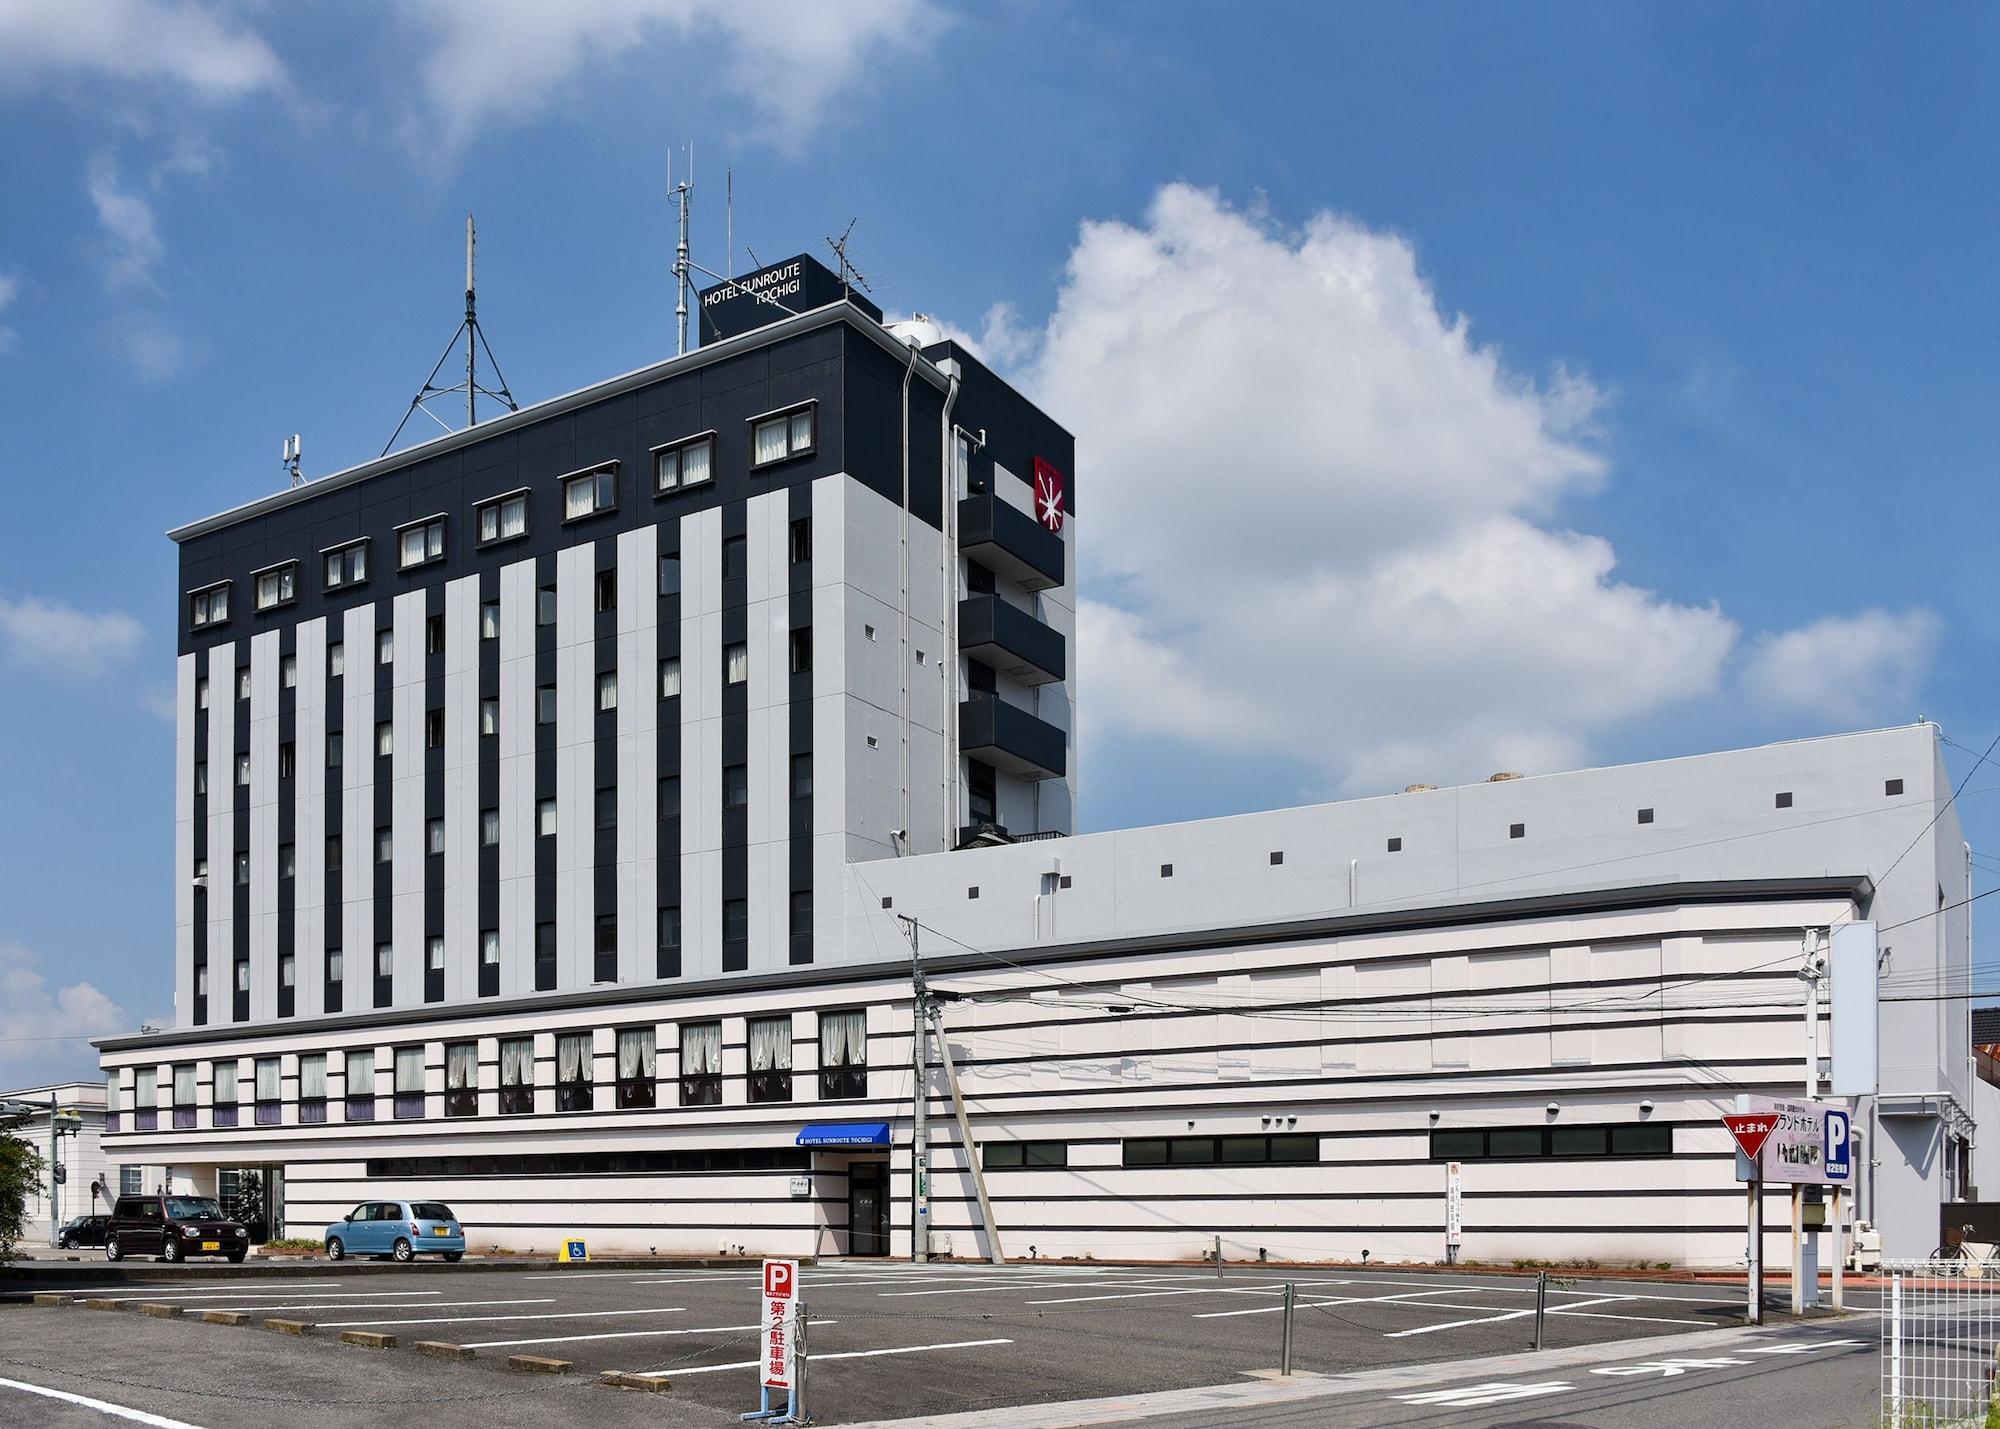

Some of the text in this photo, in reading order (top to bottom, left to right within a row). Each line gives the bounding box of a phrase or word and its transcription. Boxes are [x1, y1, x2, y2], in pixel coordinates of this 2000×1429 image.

[704, 262, 800, 307] HOTEL SUNROUTE
[756, 279, 800, 305] TOCHIGI
[1734, 1122, 1769, 1134] 止まれ
[1828, 1115, 1846, 1161] P
[770, 1265, 788, 1292] P
[769, 1301, 786, 1376] 第2駐車場
